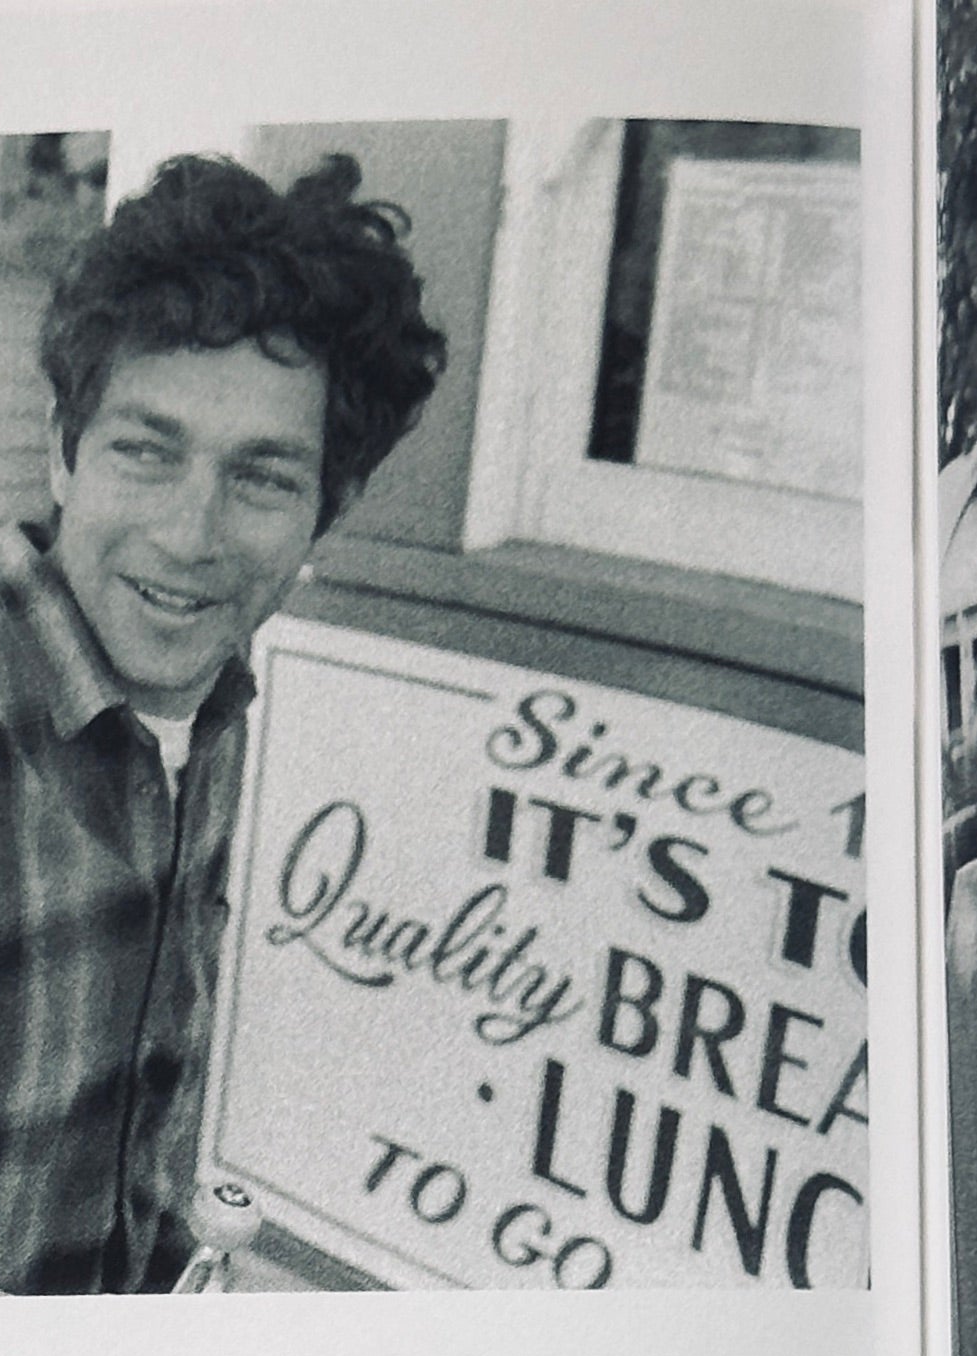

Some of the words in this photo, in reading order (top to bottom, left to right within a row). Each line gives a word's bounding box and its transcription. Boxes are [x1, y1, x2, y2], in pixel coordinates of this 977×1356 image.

[487, 689, 797, 834] Since
[268, 801, 583, 1045] Quality
[484, 788, 710, 922] IT'S
[767, 867, 867, 988] T
[362, 1135, 466, 1225] TO
[492, 1203, 612, 1291] GO
[532, 1058, 871, 1290] LUNC
